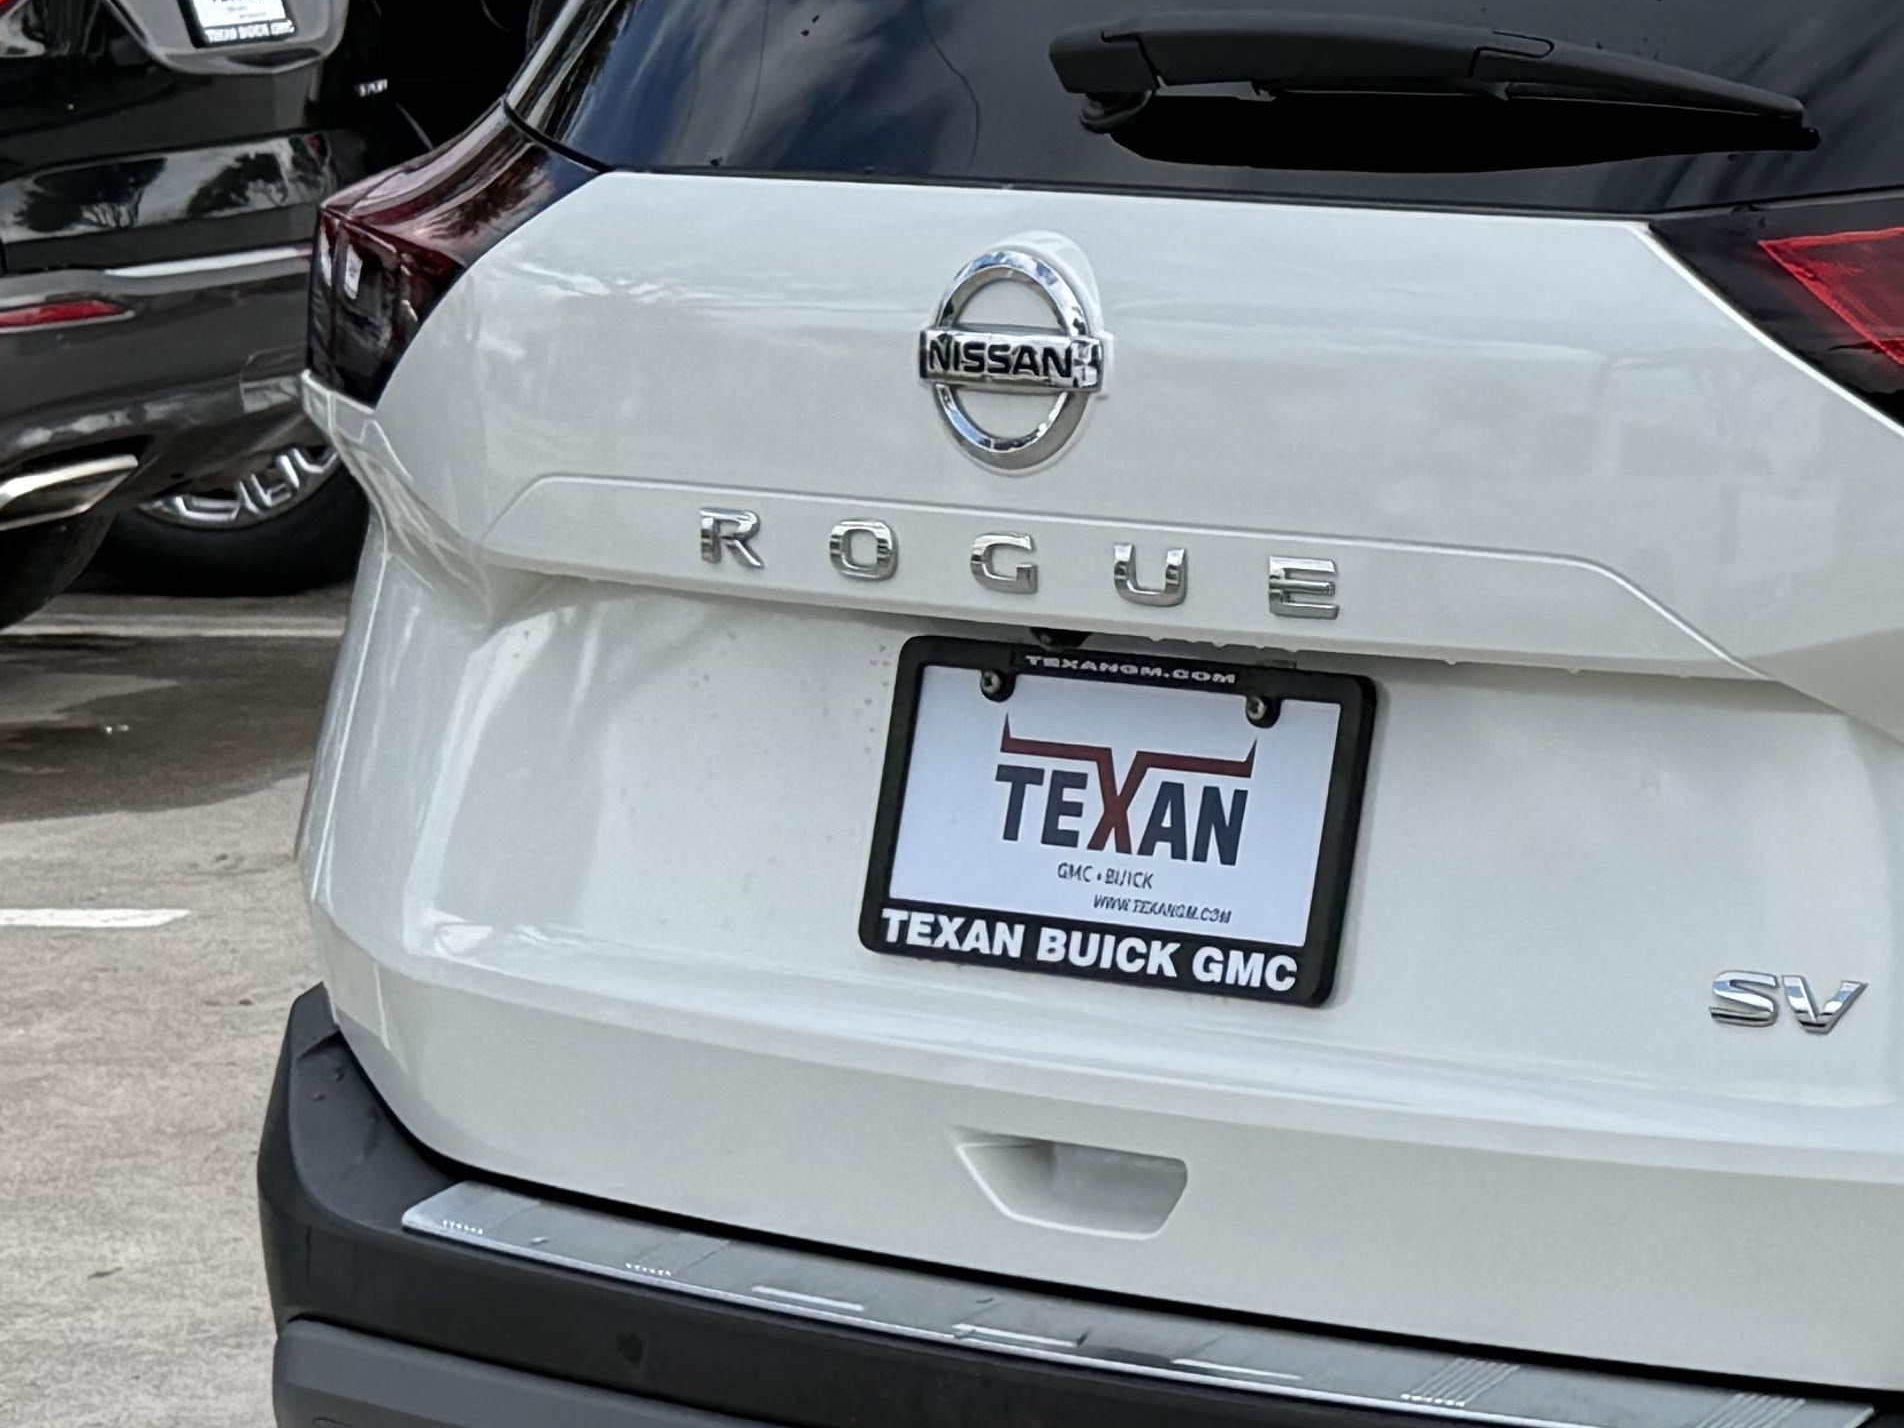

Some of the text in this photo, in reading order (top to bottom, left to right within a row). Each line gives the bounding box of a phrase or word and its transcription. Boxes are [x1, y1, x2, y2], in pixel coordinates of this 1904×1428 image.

[928, 333, 1074, 378] NISSAN
[699, 506, 1340, 621] ROGUE
[1025, 654, 1236, 684] TEXANGM.COM
[993, 712, 1258, 867] TEXAN
[1057, 862, 1095, 883] GMC
[881, 907, 1299, 992] TEXAN BUICK GMC
[1708, 969, 1870, 1035] SV
